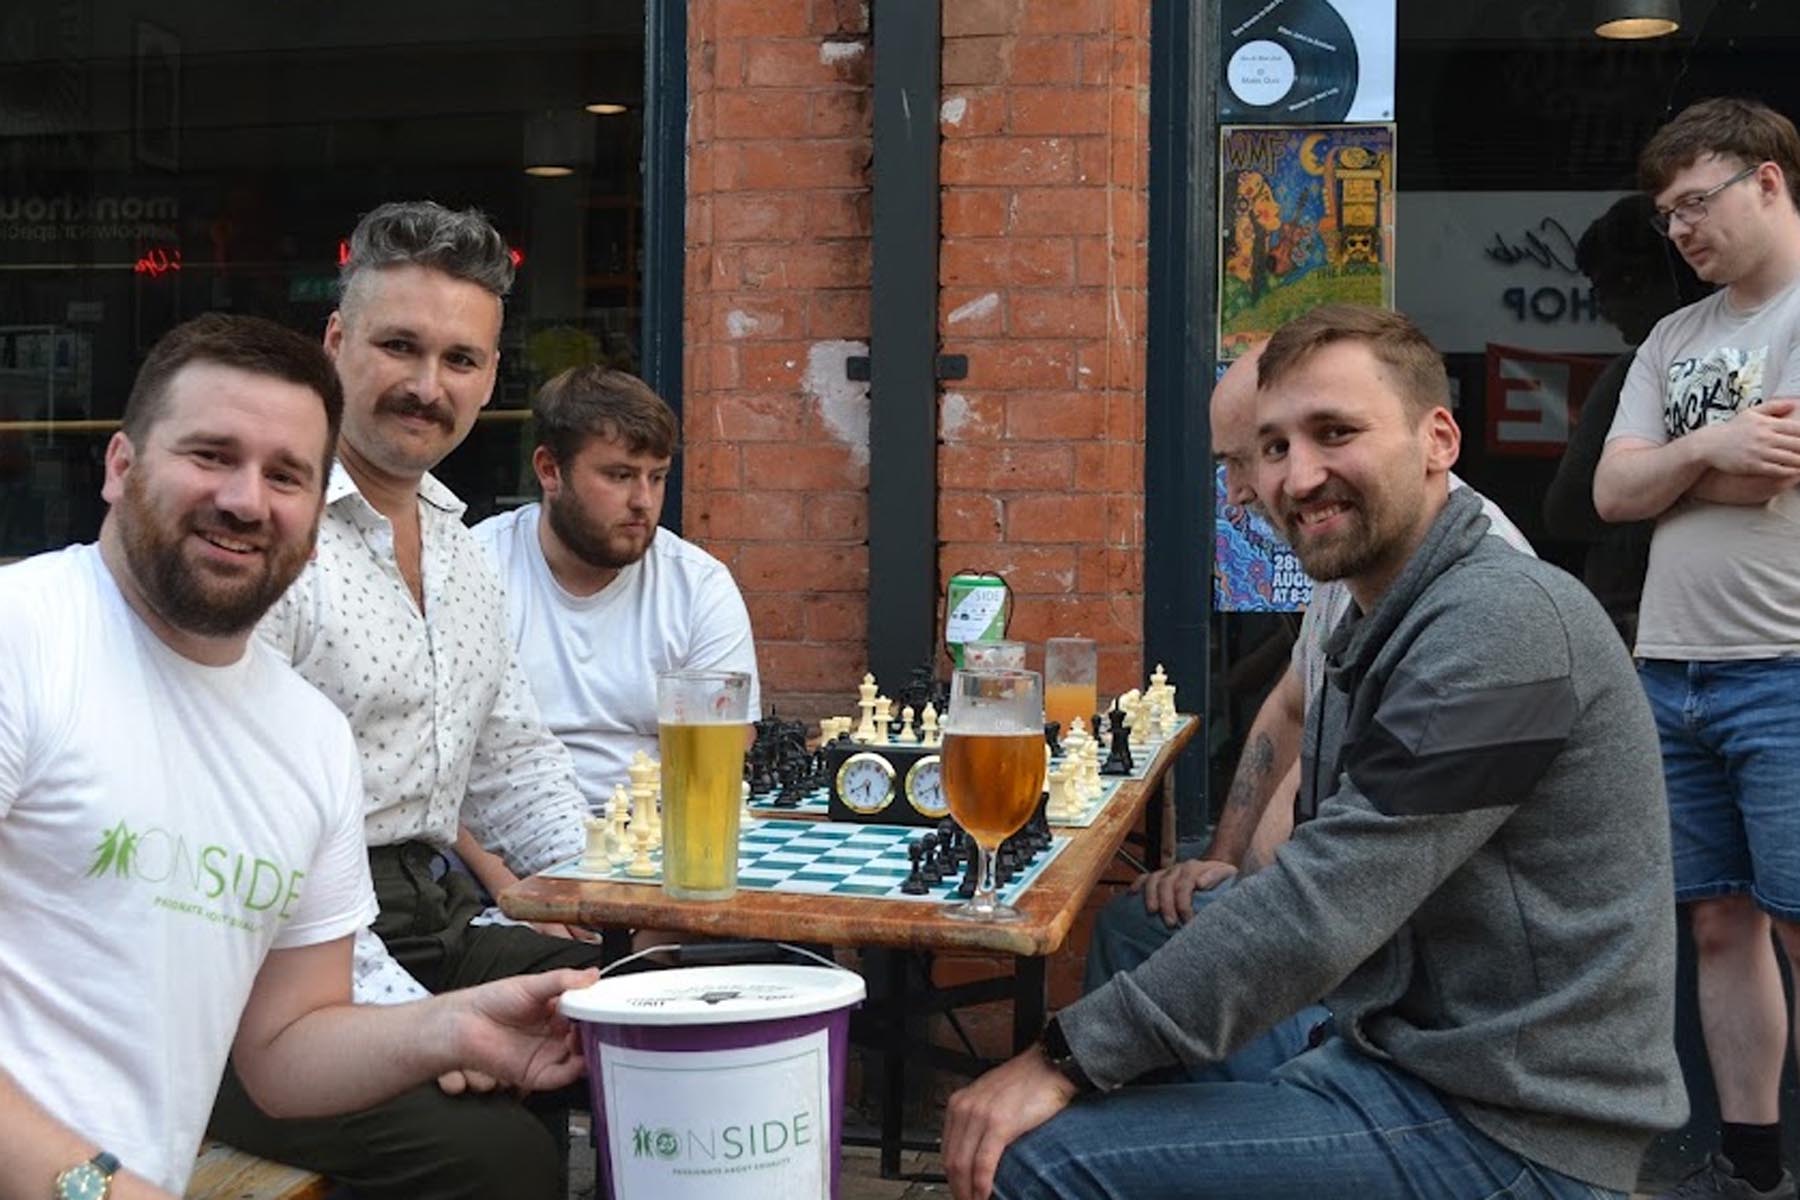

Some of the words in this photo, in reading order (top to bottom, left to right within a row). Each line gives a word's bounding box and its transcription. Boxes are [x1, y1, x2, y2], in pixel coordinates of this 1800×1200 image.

[1272, 572, 1312, 588] AUGU
[1272, 588, 1288, 603] AT
[1291, 588, 1313, 604] 8:3
[133, 828, 306, 919] ONSIDE
